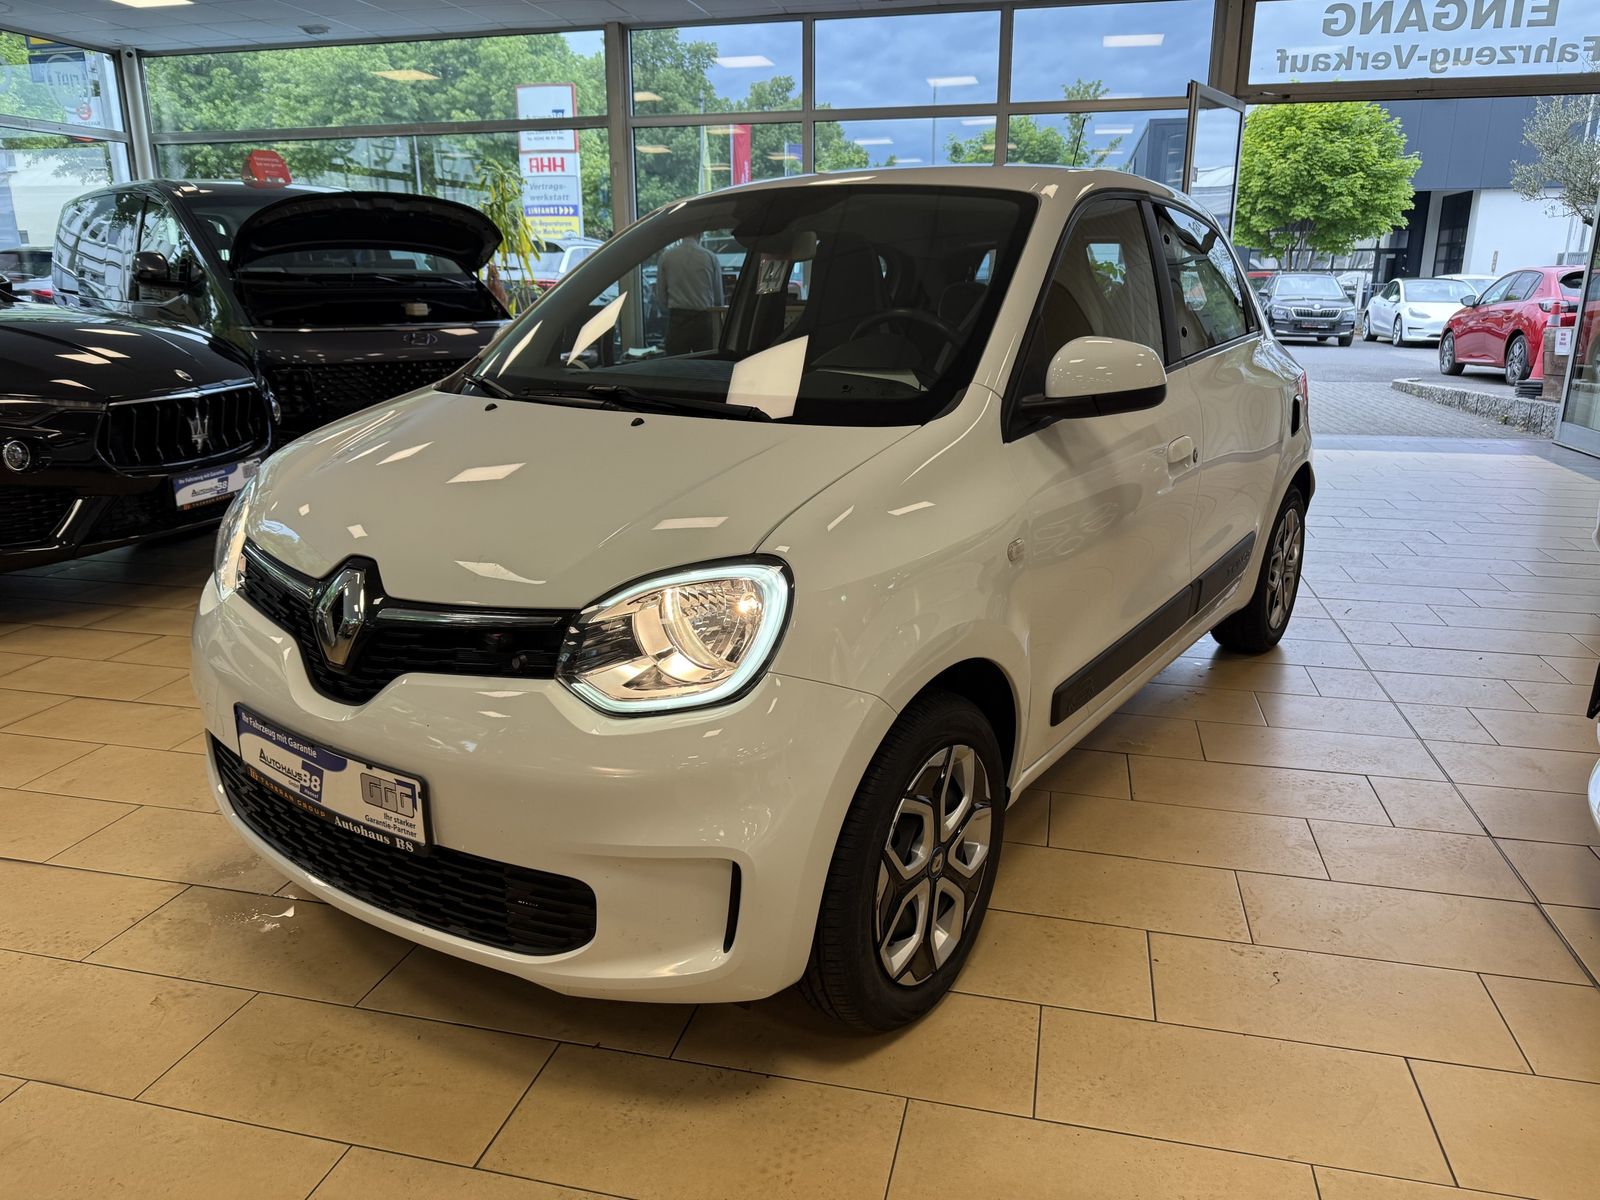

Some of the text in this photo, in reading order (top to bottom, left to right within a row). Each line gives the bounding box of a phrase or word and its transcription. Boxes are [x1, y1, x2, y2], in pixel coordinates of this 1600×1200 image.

[529, 157, 566, 173] AHH
[529, 182, 567, 193] Vertrags-
[529, 193, 570, 202] werkstatt
[527, 205, 558, 215] EINFAHRT
[241, 712, 318, 758] Ihr Fahrzeug mit Garantie
[300, 769, 321, 792] B8
[364, 814, 417, 838] Garantie-Partner
[383, 812, 417, 829] Ihr starker
[334, 815, 414, 853] Autohaus B8
